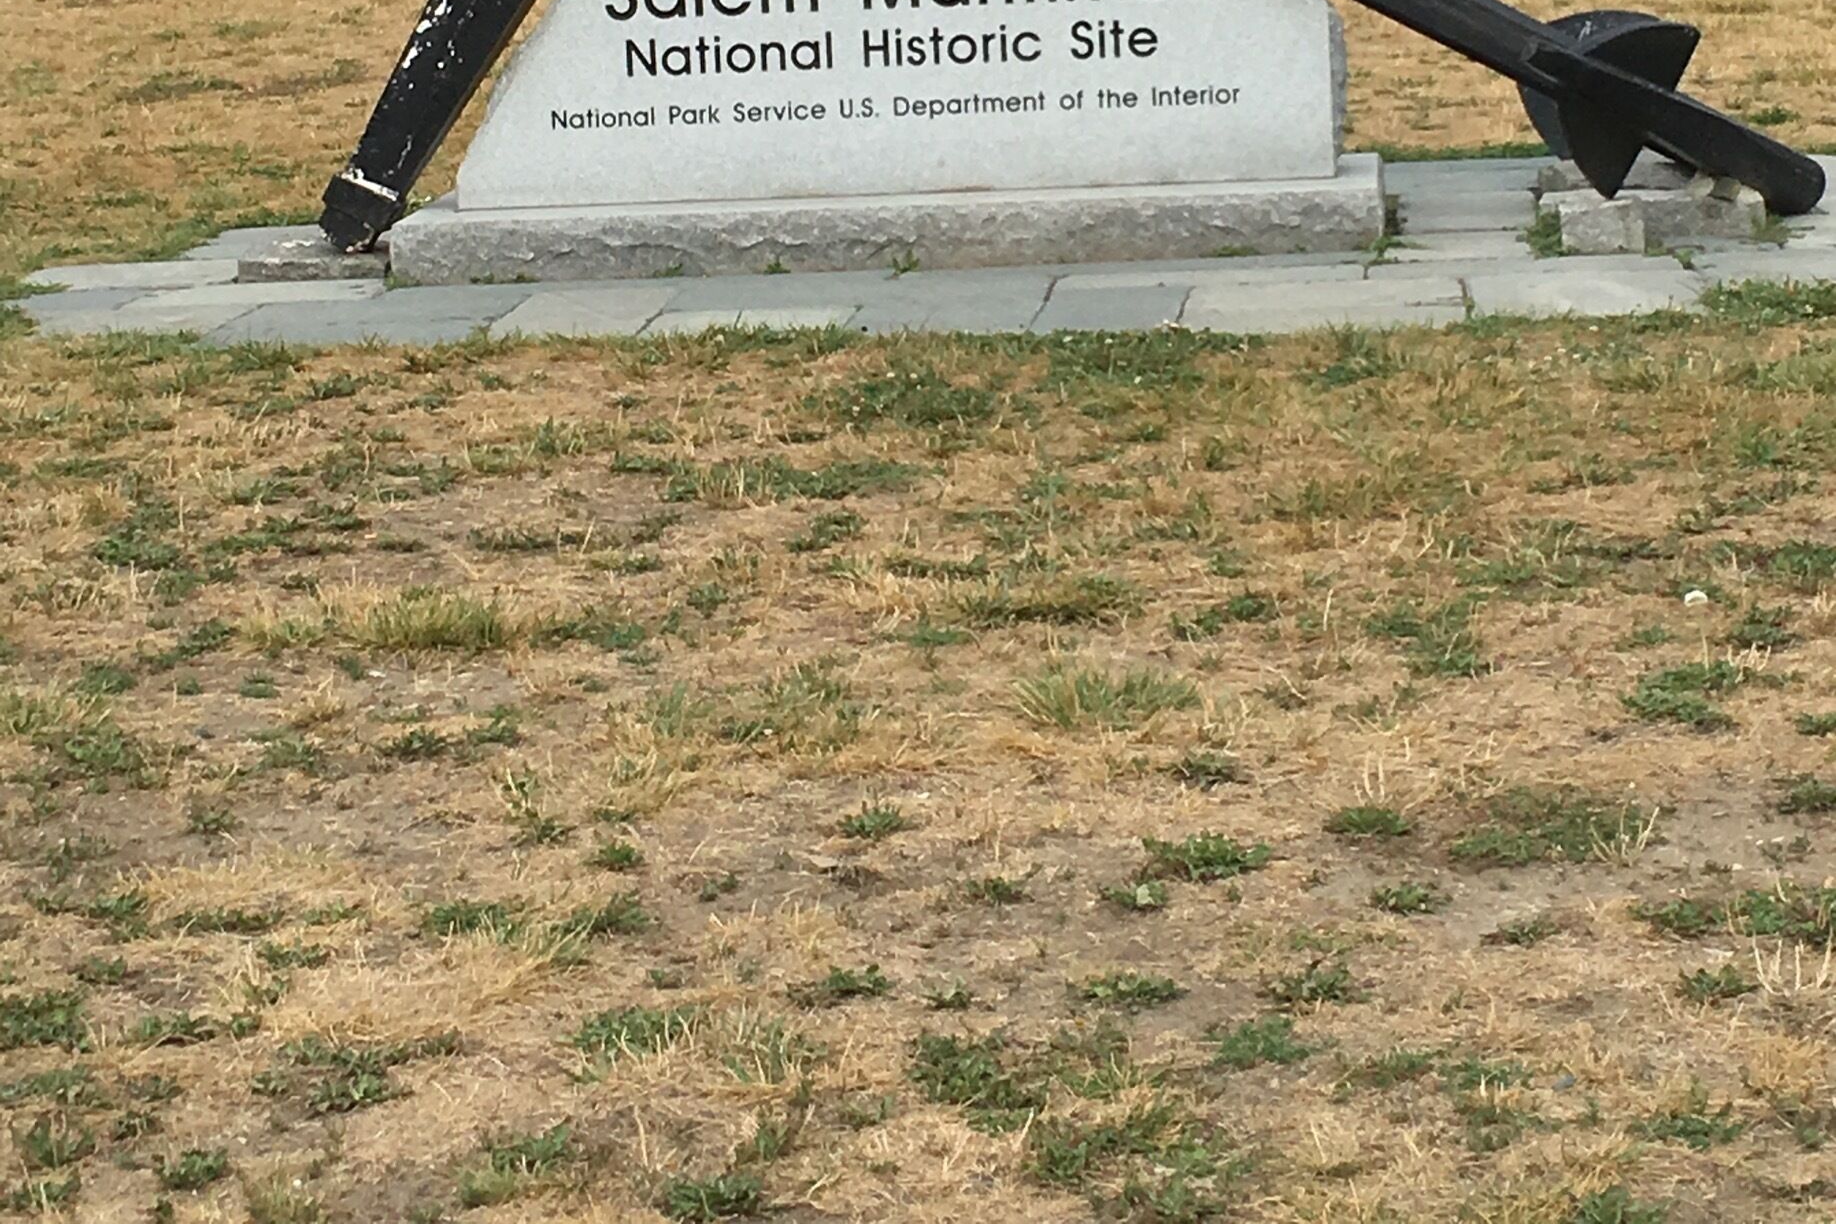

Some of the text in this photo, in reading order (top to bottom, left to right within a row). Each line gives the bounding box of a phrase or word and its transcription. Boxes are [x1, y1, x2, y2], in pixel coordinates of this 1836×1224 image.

[625, 19, 1159, 78] National Historic Site
[550, 84, 1241, 131] National Park Service U.S. Department of the Interior
